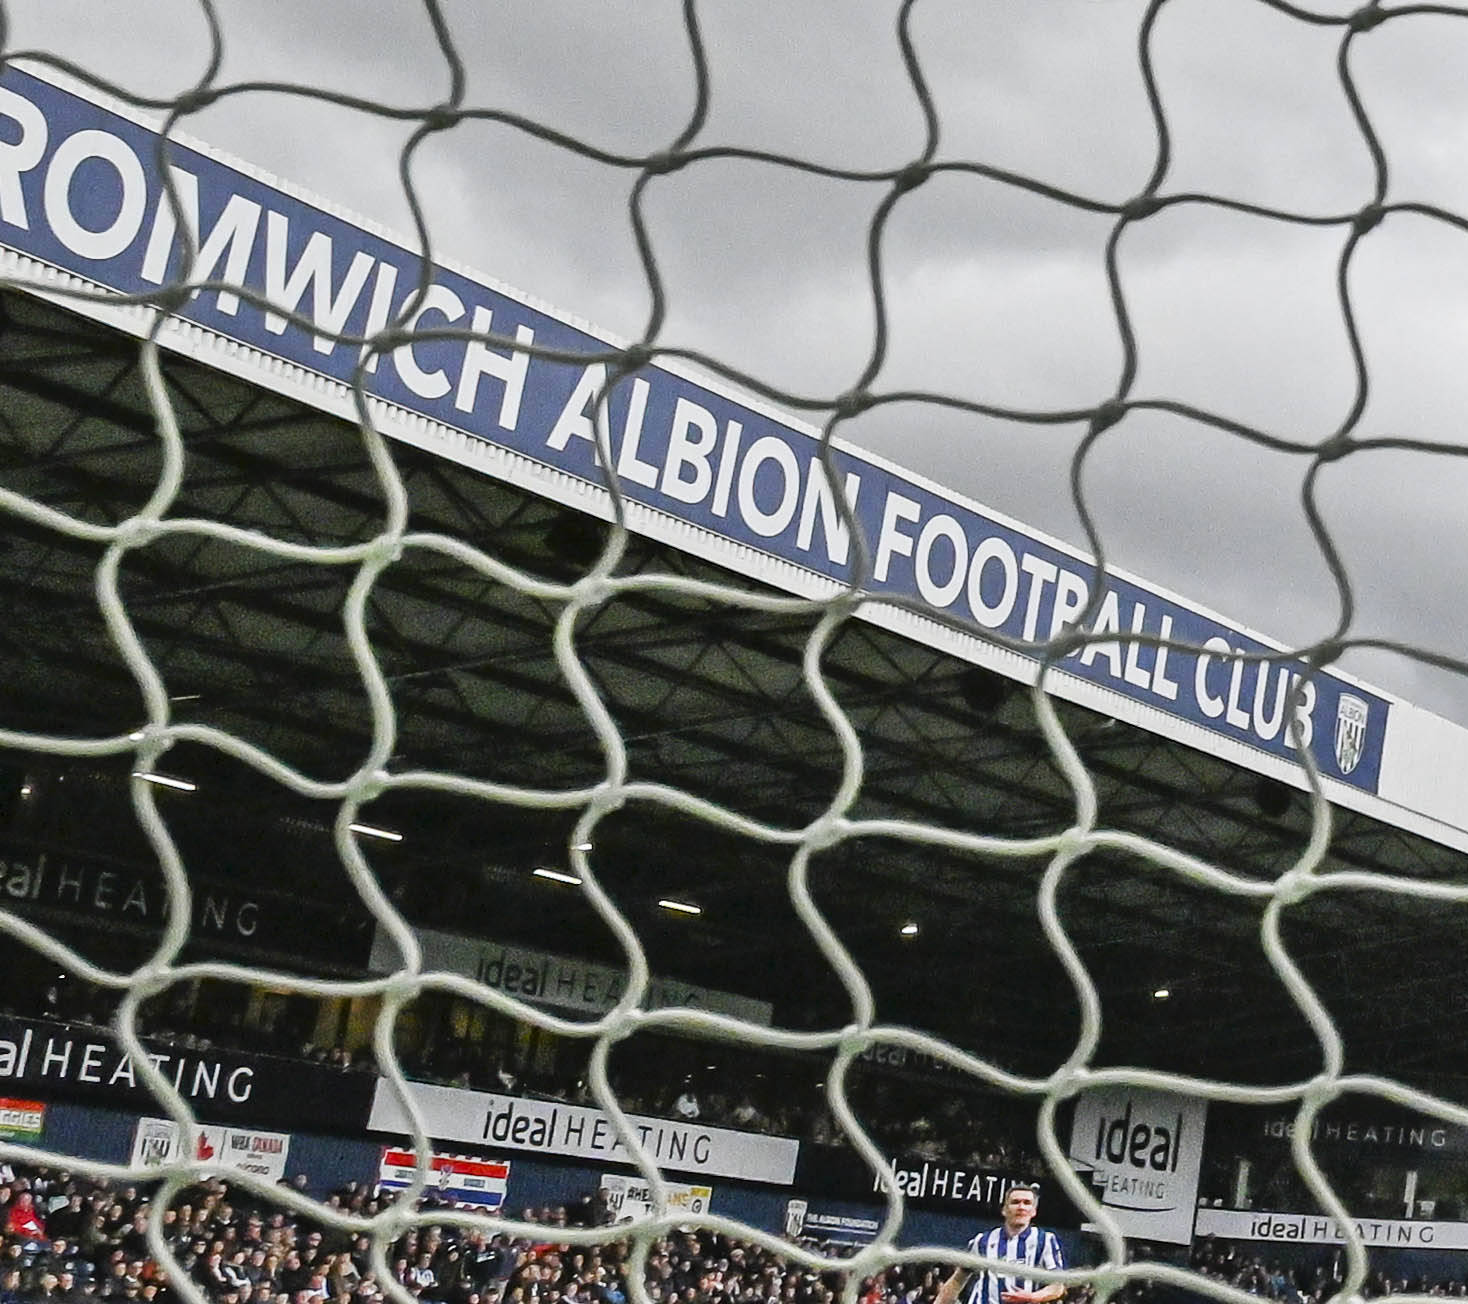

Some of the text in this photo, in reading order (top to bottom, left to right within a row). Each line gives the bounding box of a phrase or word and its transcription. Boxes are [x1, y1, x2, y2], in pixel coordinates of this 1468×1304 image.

[547, 363, 858, 566] ALBION
[873, 490, 1179, 700] FOOTBALL
[1195, 636, 1317, 751] CLUB
[57, 864, 260, 937] HEANG
[477, 948, 702, 1014] ideal HEAIN
[41, 1037, 255, 1104] HEATING
[482, 1099, 558, 1148] ideal
[1095, 1100, 1183, 1174] ideal
[1263, 1121, 1447, 1148] idel HEATING
[932, 1167, 1041, 1206] HEATI
[1250, 1217, 1306, 1240] ideal
